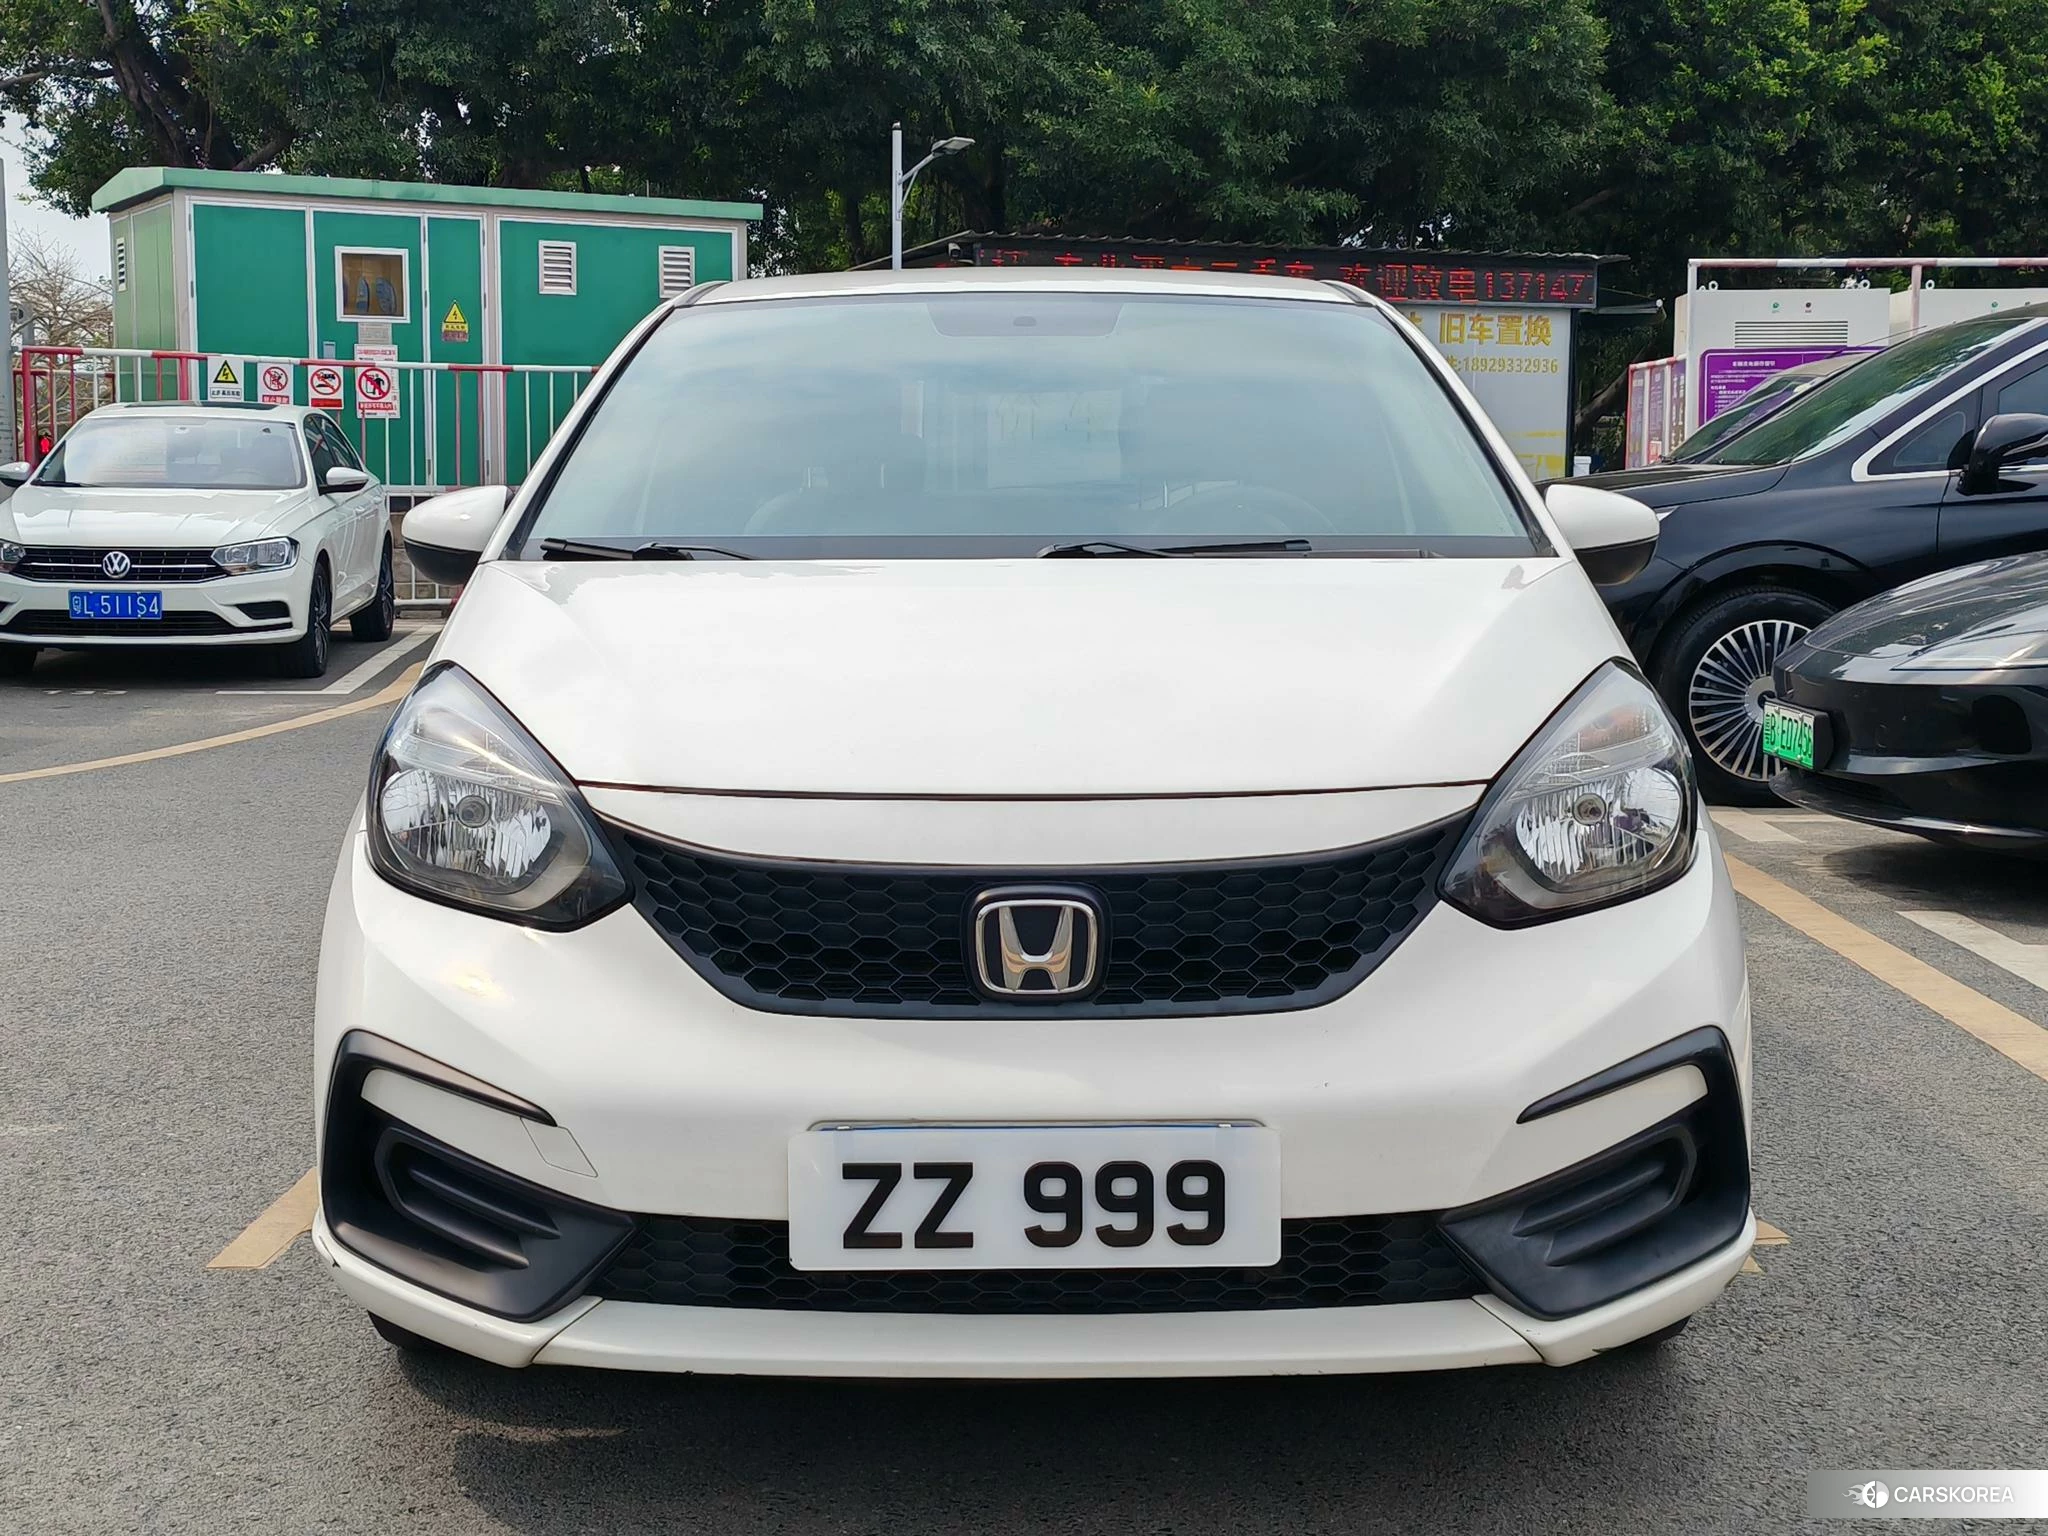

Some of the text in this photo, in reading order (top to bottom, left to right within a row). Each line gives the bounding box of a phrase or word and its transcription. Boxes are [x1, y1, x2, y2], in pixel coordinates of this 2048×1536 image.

[1339, 263, 1593, 303] 欢迎致电137147
[1439, 312, 1552, 346] 旧车置换
[842, 1159, 1226, 1249] ZZ 999
